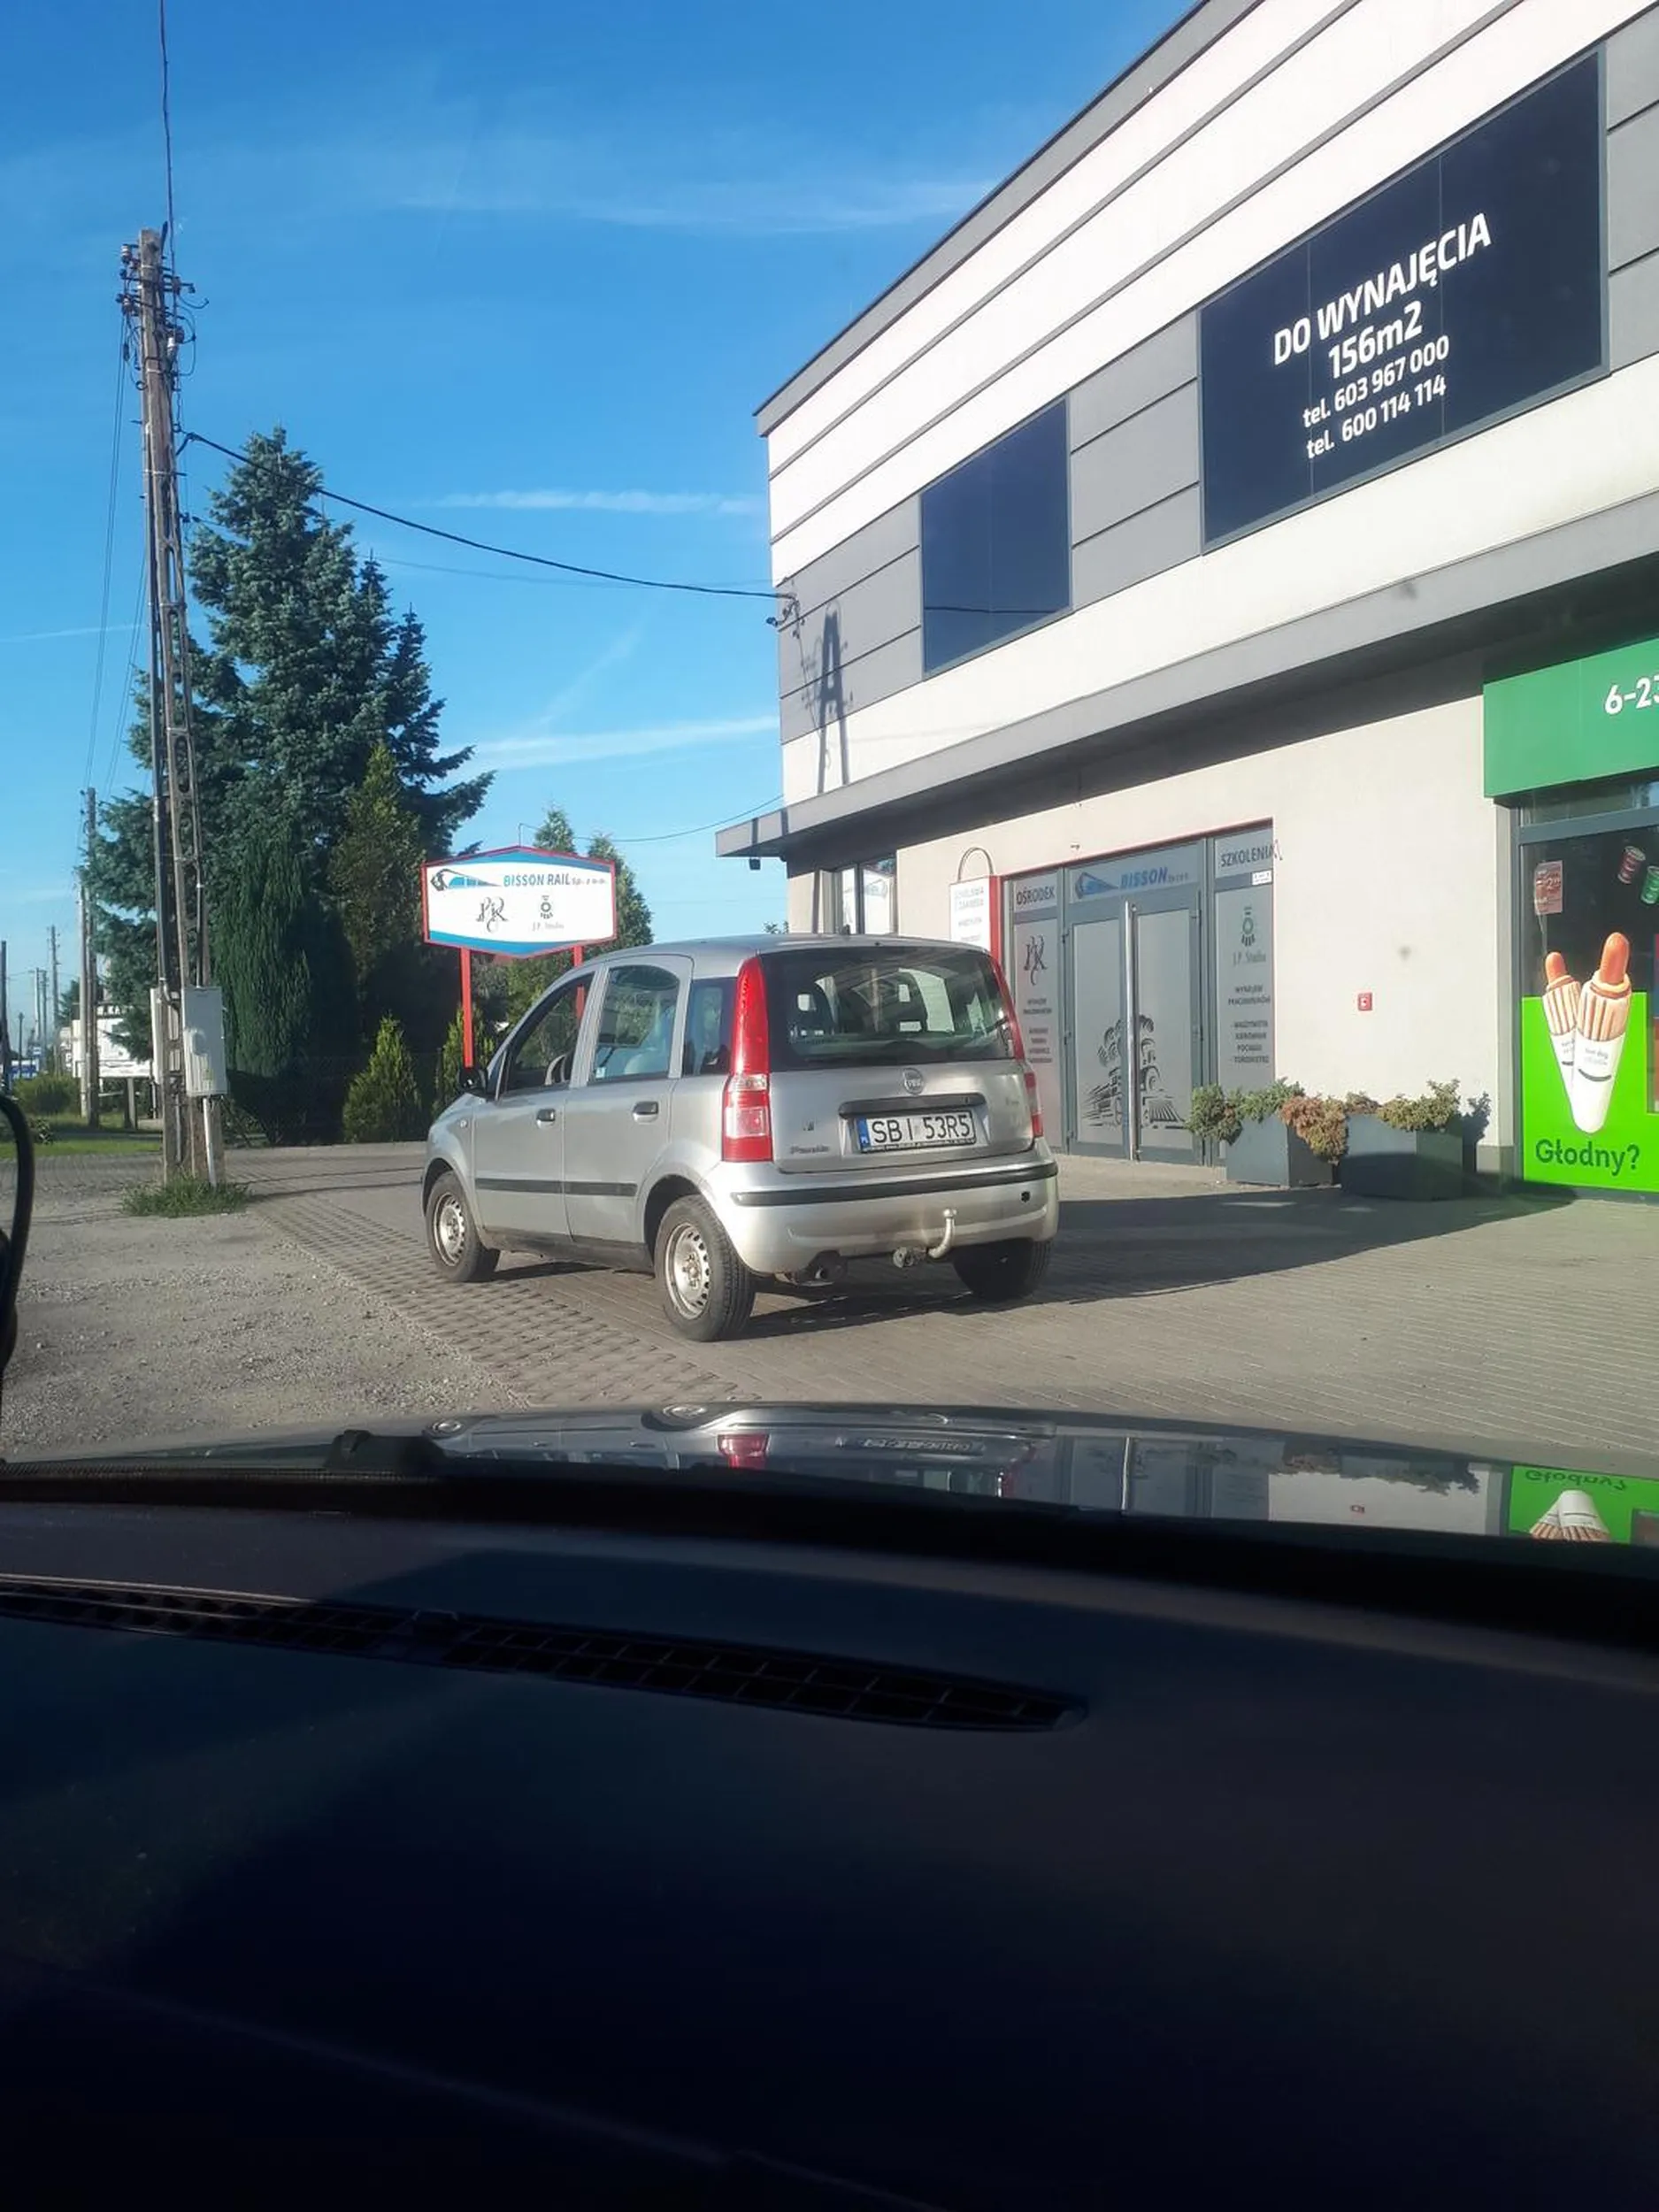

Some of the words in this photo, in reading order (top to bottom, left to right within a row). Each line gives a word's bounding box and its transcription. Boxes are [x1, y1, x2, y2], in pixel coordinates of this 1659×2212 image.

[1274, 318, 1310, 365] DO
[1317, 213, 1492, 341] WYNAJĘCIA
[1328, 301, 1423, 379] 156m2
[1302, 399, 1331, 427] tel.
[1334, 377, 1368, 412] 603
[1372, 357, 1406, 393] 967
[1410, 335, 1449, 373] 000
[1307, 430, 1334, 459] tel.
[1341, 408, 1377, 442] 600
[1380, 391, 1410, 422] 114
[1415, 374, 1446, 406] 114
[503, 873, 544, 887] BISSON
[547, 872, 571, 886] RAIL
[1017, 886, 1056, 905] OŚRODEK
[1120, 866, 1168, 889] BISSON
[923, 1114, 971, 1140] 53R5
[1536, 1139, 1640, 1177] Głodny?
